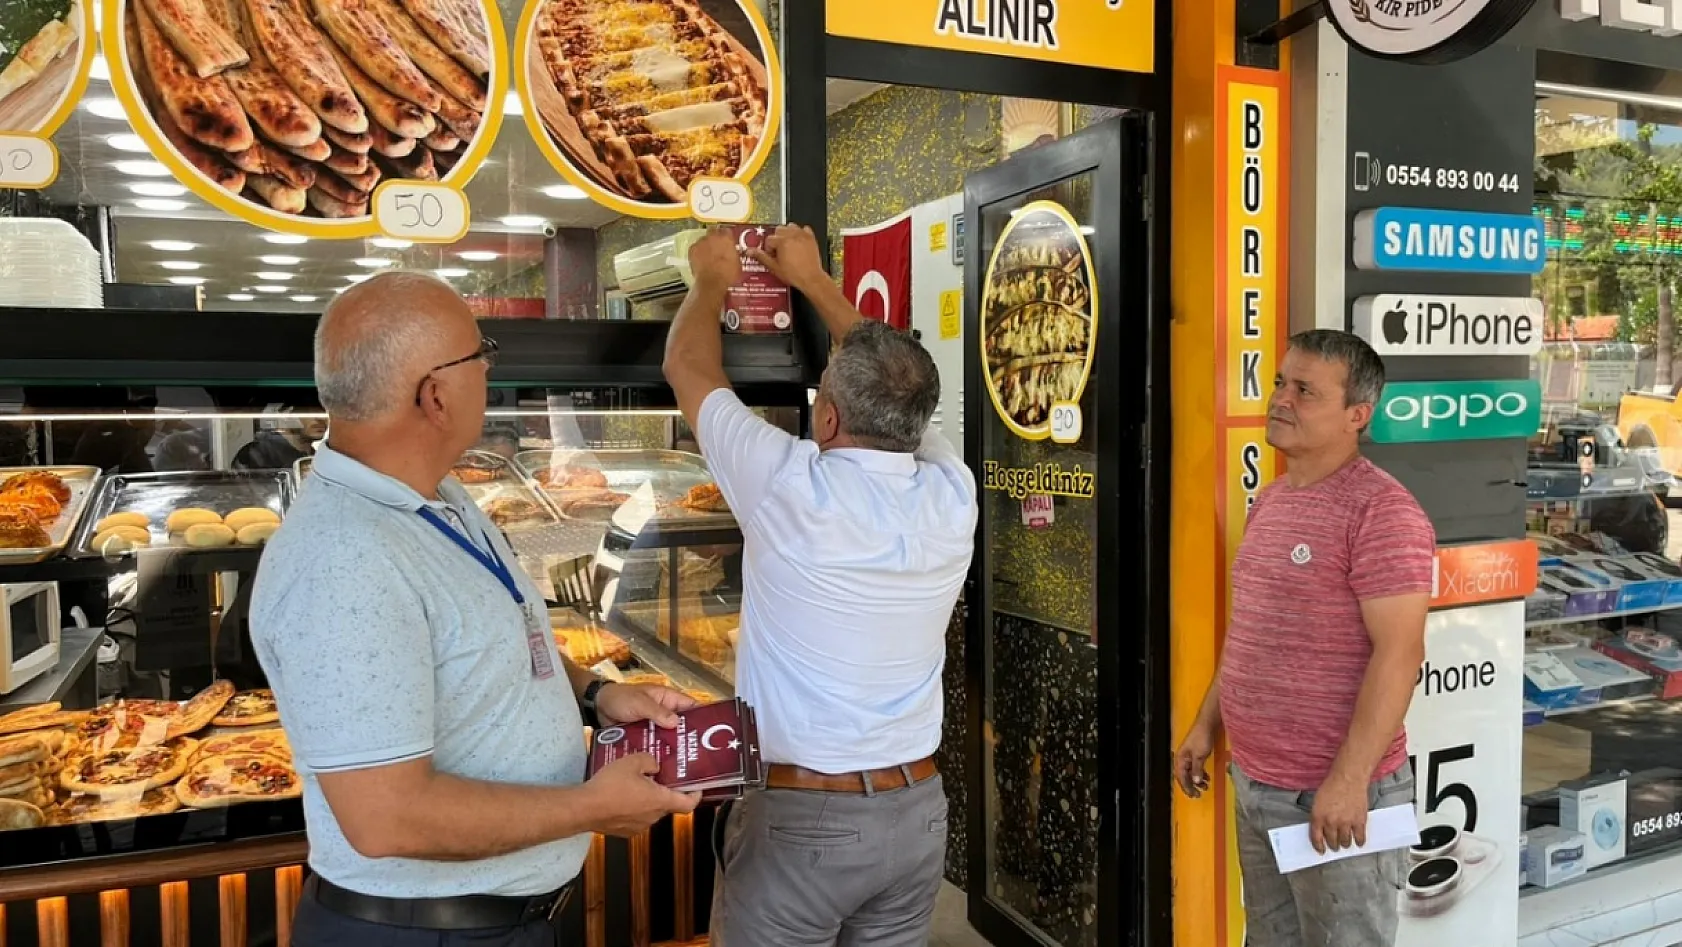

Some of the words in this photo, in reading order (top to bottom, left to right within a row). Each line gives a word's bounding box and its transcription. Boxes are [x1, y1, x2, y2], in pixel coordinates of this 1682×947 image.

[937, 0, 1056, 46] ALINIR
[1386, 164, 1431, 187] 0554
[1436, 168, 1468, 189] 893
[1473, 171, 1494, 191] 00
[1498, 173, 1519, 193] 44
[394, 192, 443, 227] 50
[1242, 102, 1262, 400] BÖREK
[1384, 221, 1538, 261] SAMSUNG
[1416, 302, 1532, 345] iPhone
[1385, 392, 1528, 429] oppo
[984, 461, 1094, 498] Hoşgeldiniz
[1442, 562, 1520, 597] Xiaomi
[1633, 815, 1663, 837] 0554
